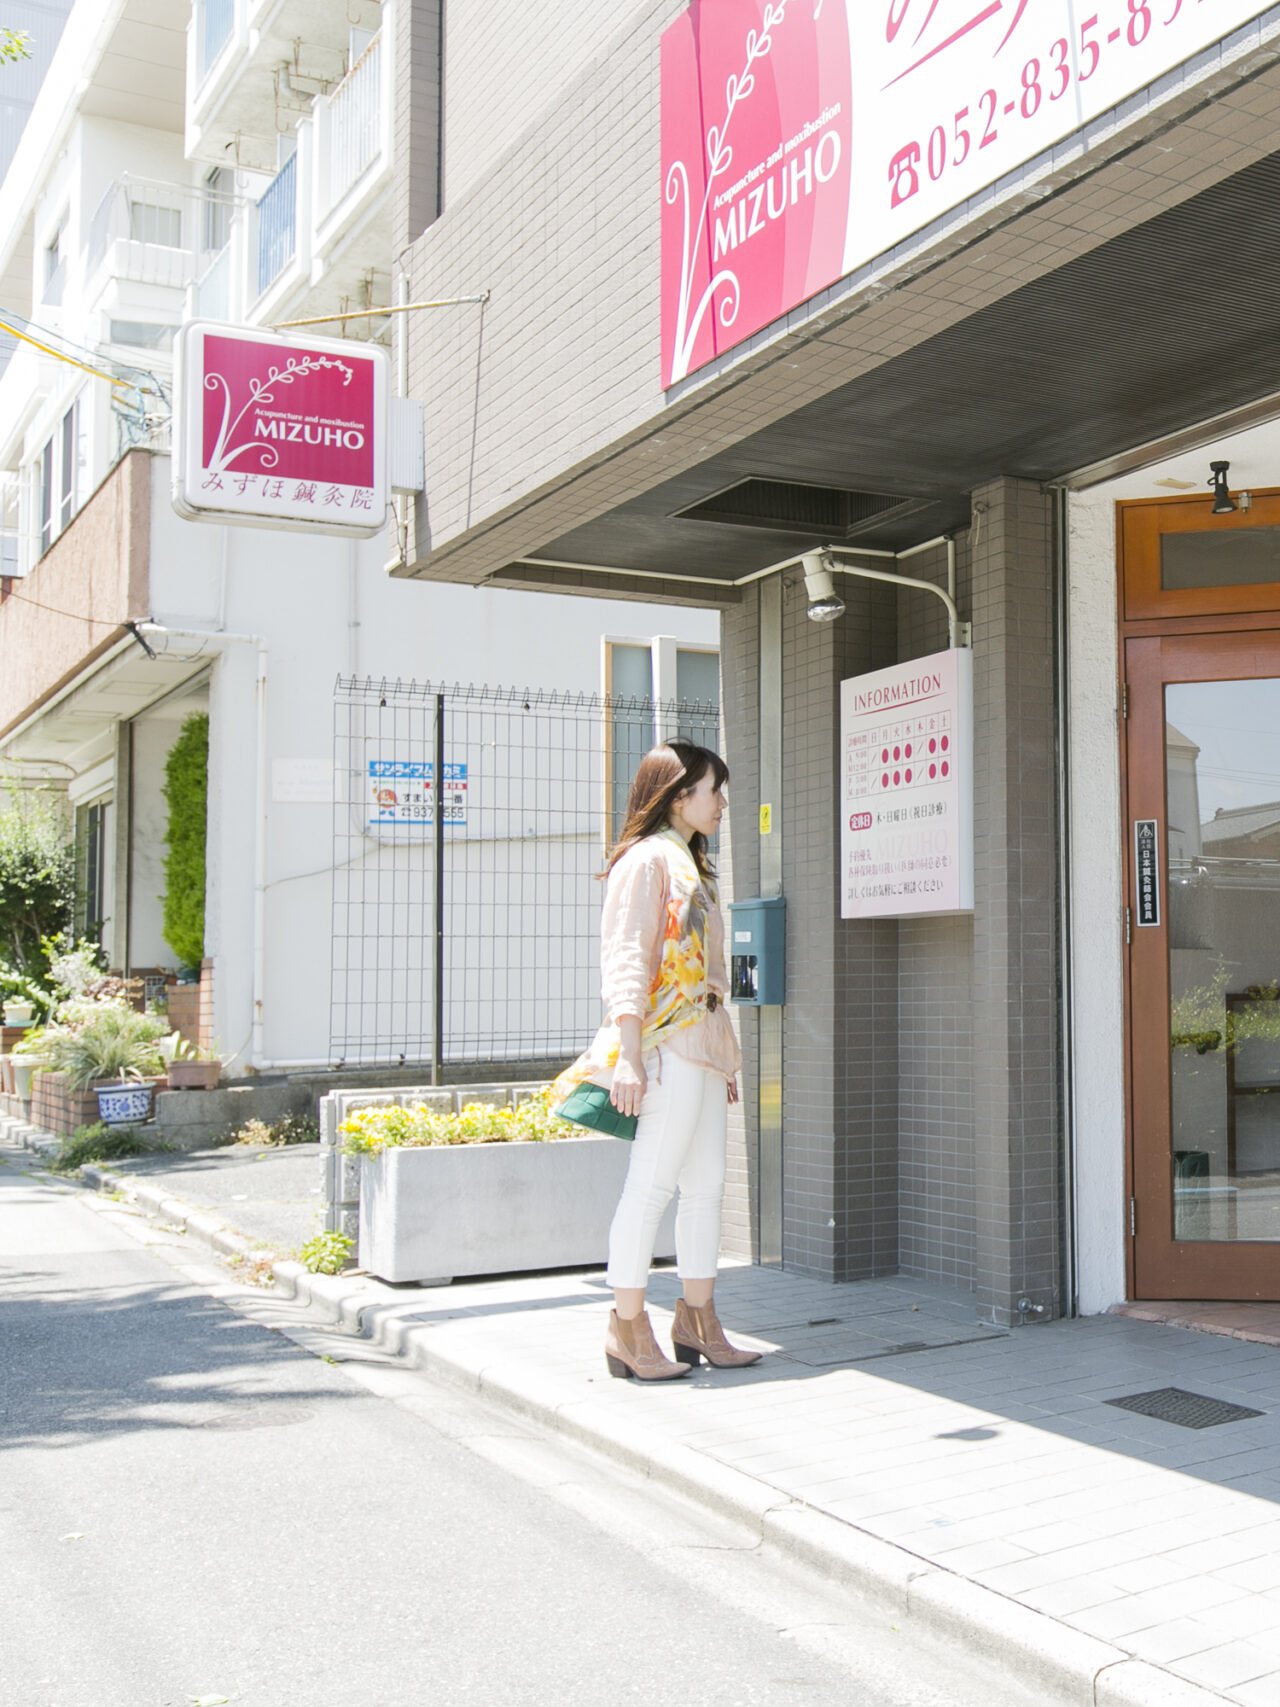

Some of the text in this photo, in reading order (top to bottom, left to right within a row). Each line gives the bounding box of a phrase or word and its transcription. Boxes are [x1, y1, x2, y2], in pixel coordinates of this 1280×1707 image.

[927, 0, 1202, 181] 052-835-8
[713, 102, 841, 211] Acupuncture and moxibustion
[713, 130, 842, 263] MIZUHO
[254, 408, 302, 422] Acupuncture
[304, 415, 318, 424] and
[254, 419, 364, 450] MIZUHO
[201, 472, 374, 510] みずほ鍼灸院
[854, 672, 941, 712] INFORMATION
[374, 763, 461, 777] サンライフムカミ
